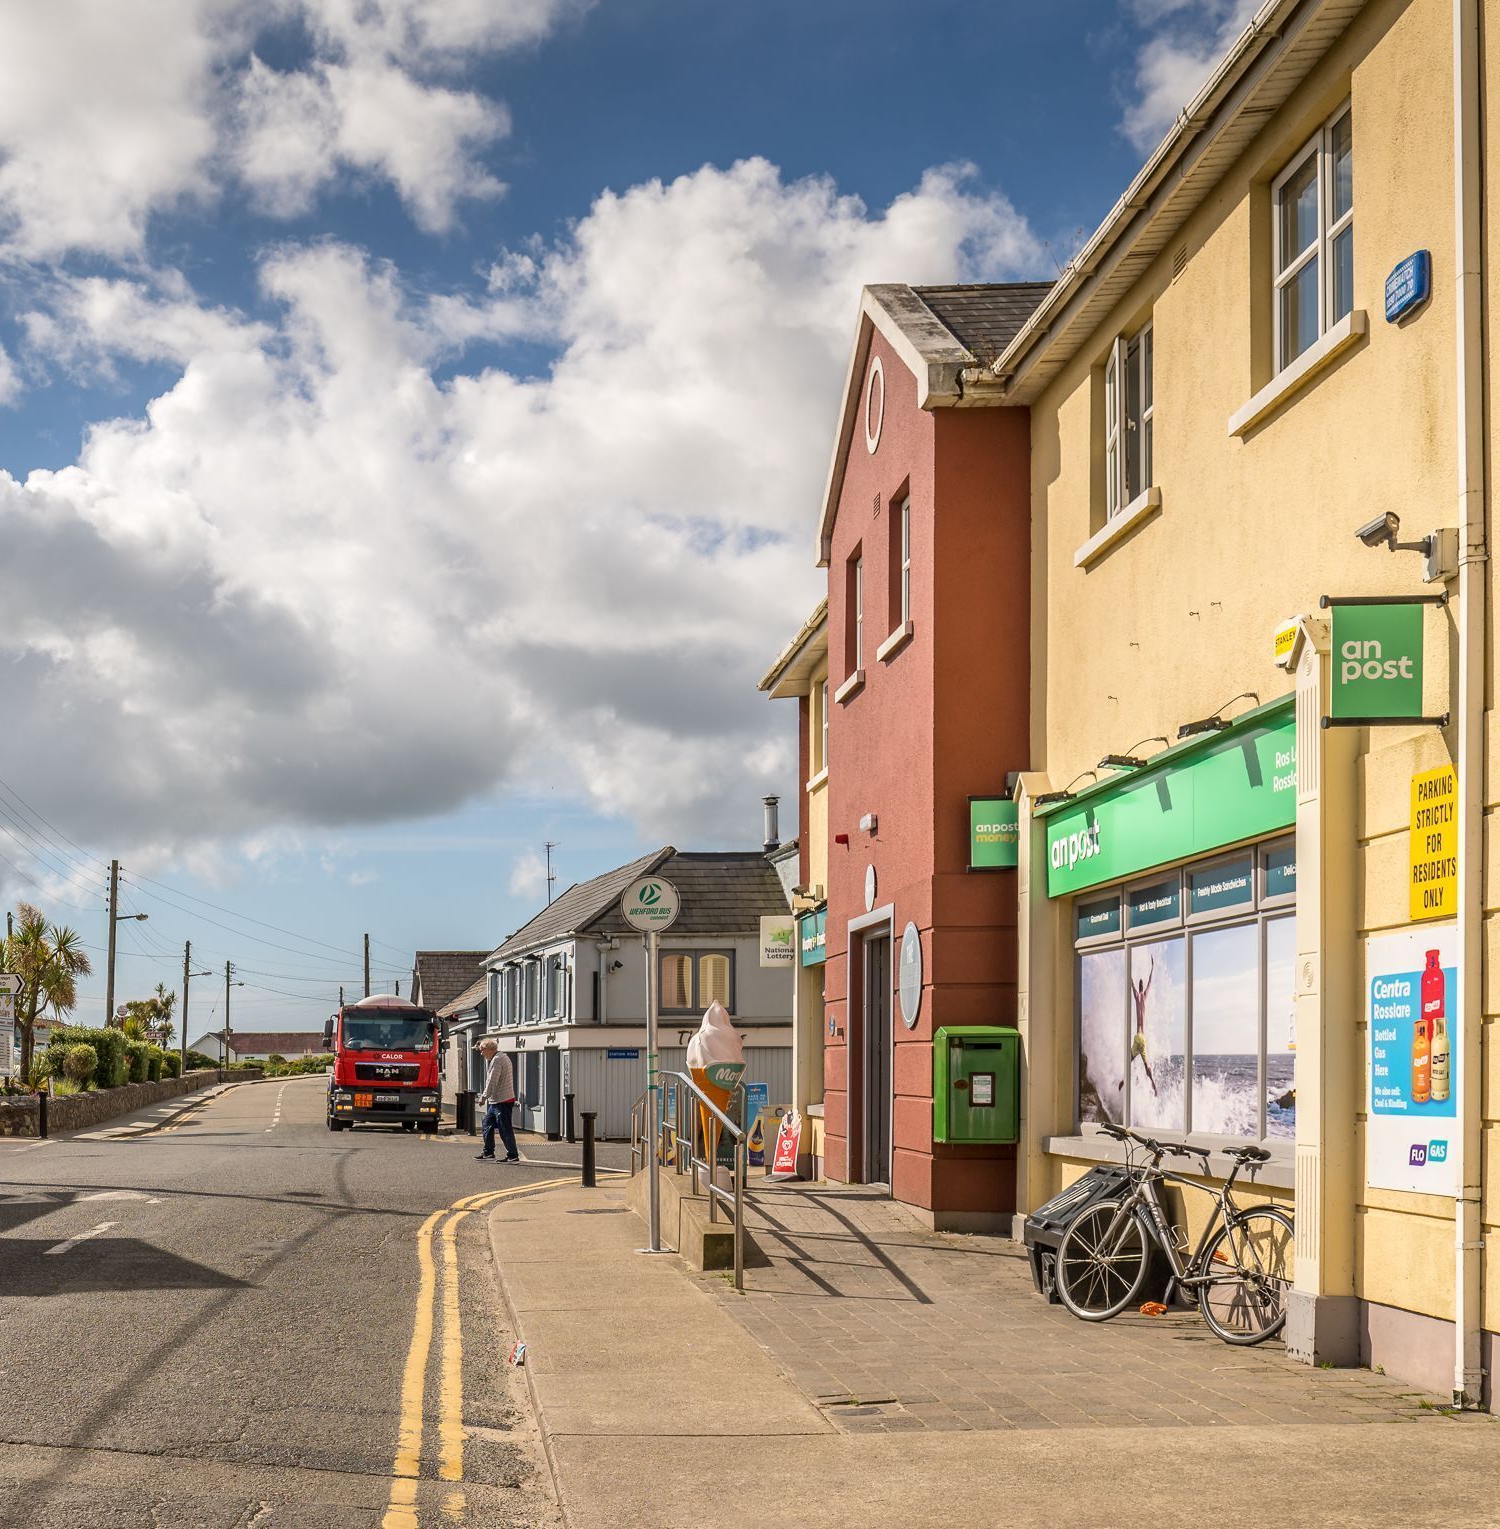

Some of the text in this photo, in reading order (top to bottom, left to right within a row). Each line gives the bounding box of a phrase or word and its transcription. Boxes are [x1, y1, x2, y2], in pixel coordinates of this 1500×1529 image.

[1275, 630, 1297, 648] STANLEY
[1341, 640, 1382, 660] an
[1341, 656, 1414, 685] post
[1275, 745, 1297, 769] Ros L
[1418, 774, 1453, 802] PARKING
[1416, 802, 1454, 830] STRICTLY
[975, 833, 1017, 843] money
[1426, 833, 1442, 854] FOR
[1413, 857, 1457, 884] RESIDENTS
[1197, 878, 1247, 897] Freshly Made Sandwiches
[1423, 887, 1444, 909] ONLY
[766, 953, 795, 961] Lottery
[1373, 980, 1411, 999] Centra
[1373, 1002, 1411, 1020] Rosslare
[1374, 1028, 1397, 1042] Bottled
[1374, 1046, 1386, 1059] Gas
[1374, 1064, 1389, 1076] Here
[1411, 1144, 1446, 1161] FLO GAS
